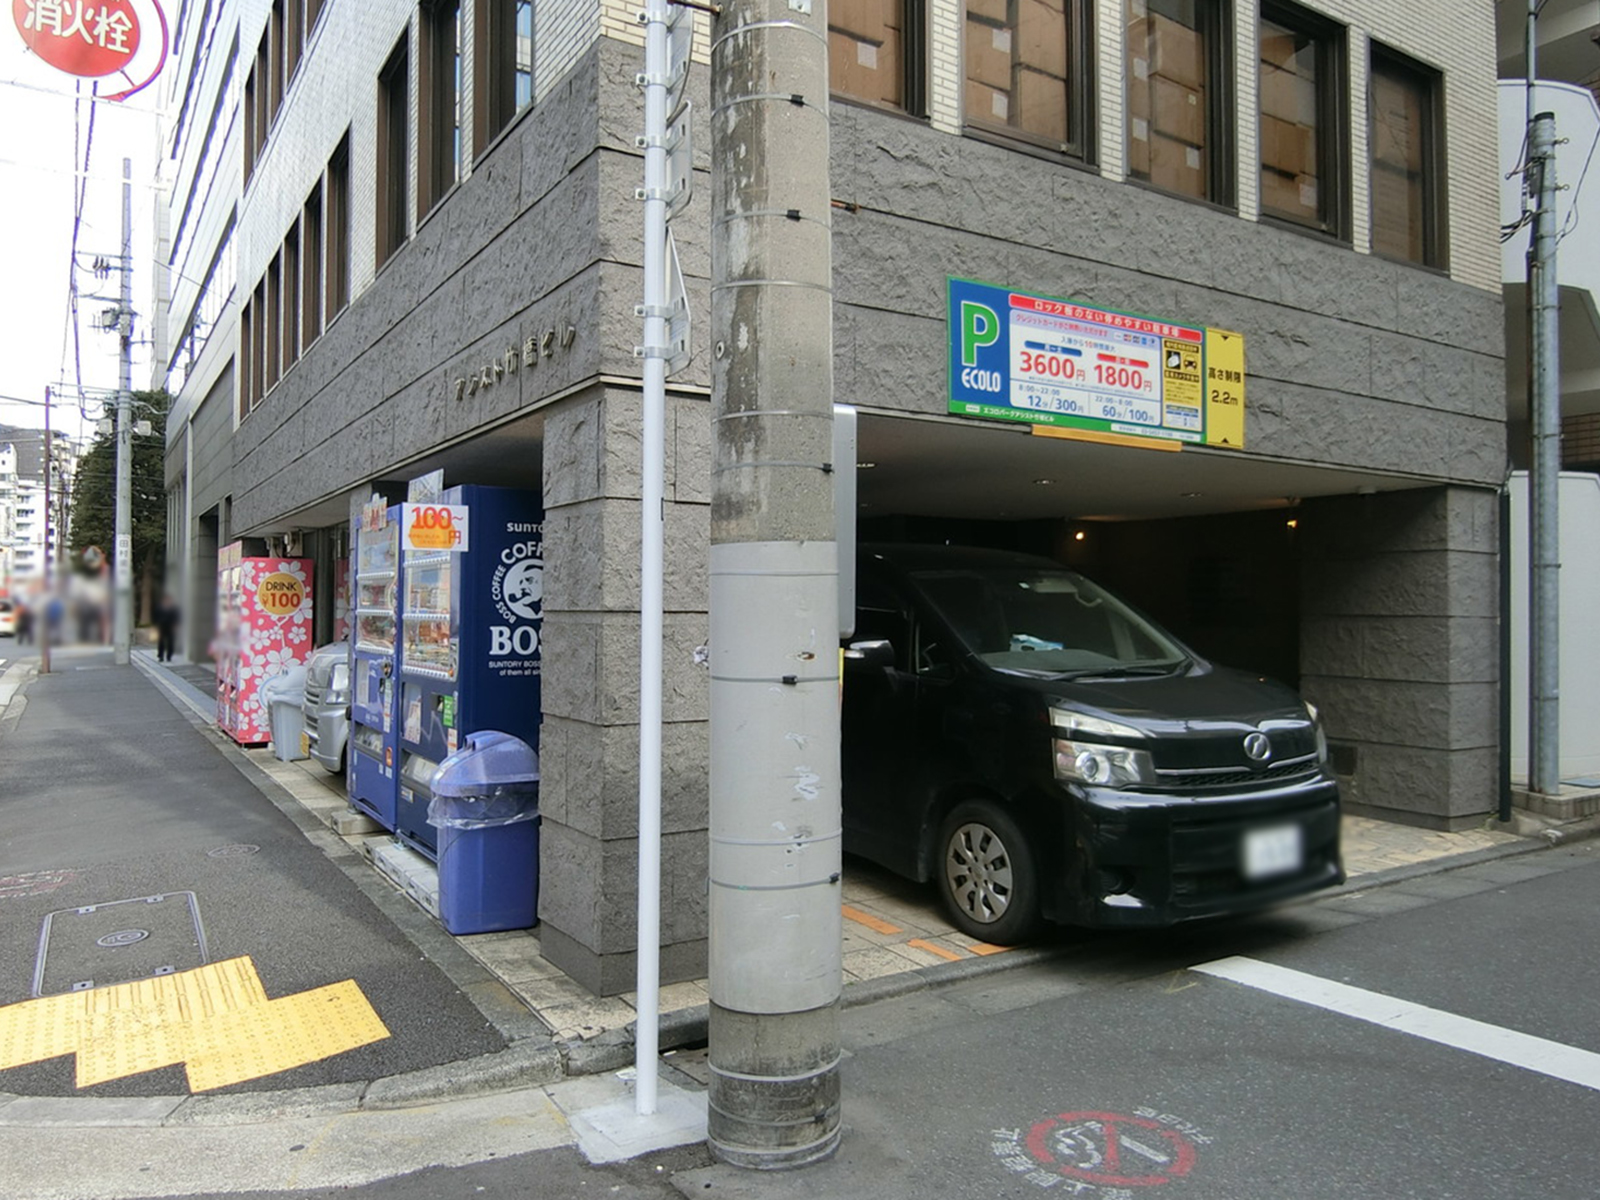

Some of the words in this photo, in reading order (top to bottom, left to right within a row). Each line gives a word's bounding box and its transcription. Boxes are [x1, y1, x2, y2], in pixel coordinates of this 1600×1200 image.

[23, 0, 132, 54] 消火栓
[961, 300, 1000, 367] P
[961, 367, 1001, 392] ECOLO
[1208, 367, 1242, 384] 高さ制限
[1211, 389, 1239, 406] 2.2m
[448, 530, 461, 545] 円
[265, 581, 297, 591] DRINK
[491, 564, 507, 601] COFFEE
[496, 601, 517, 625] BOSS
[489, 625, 542, 656] BO
[488, 660, 522, 668] SUNTORY
